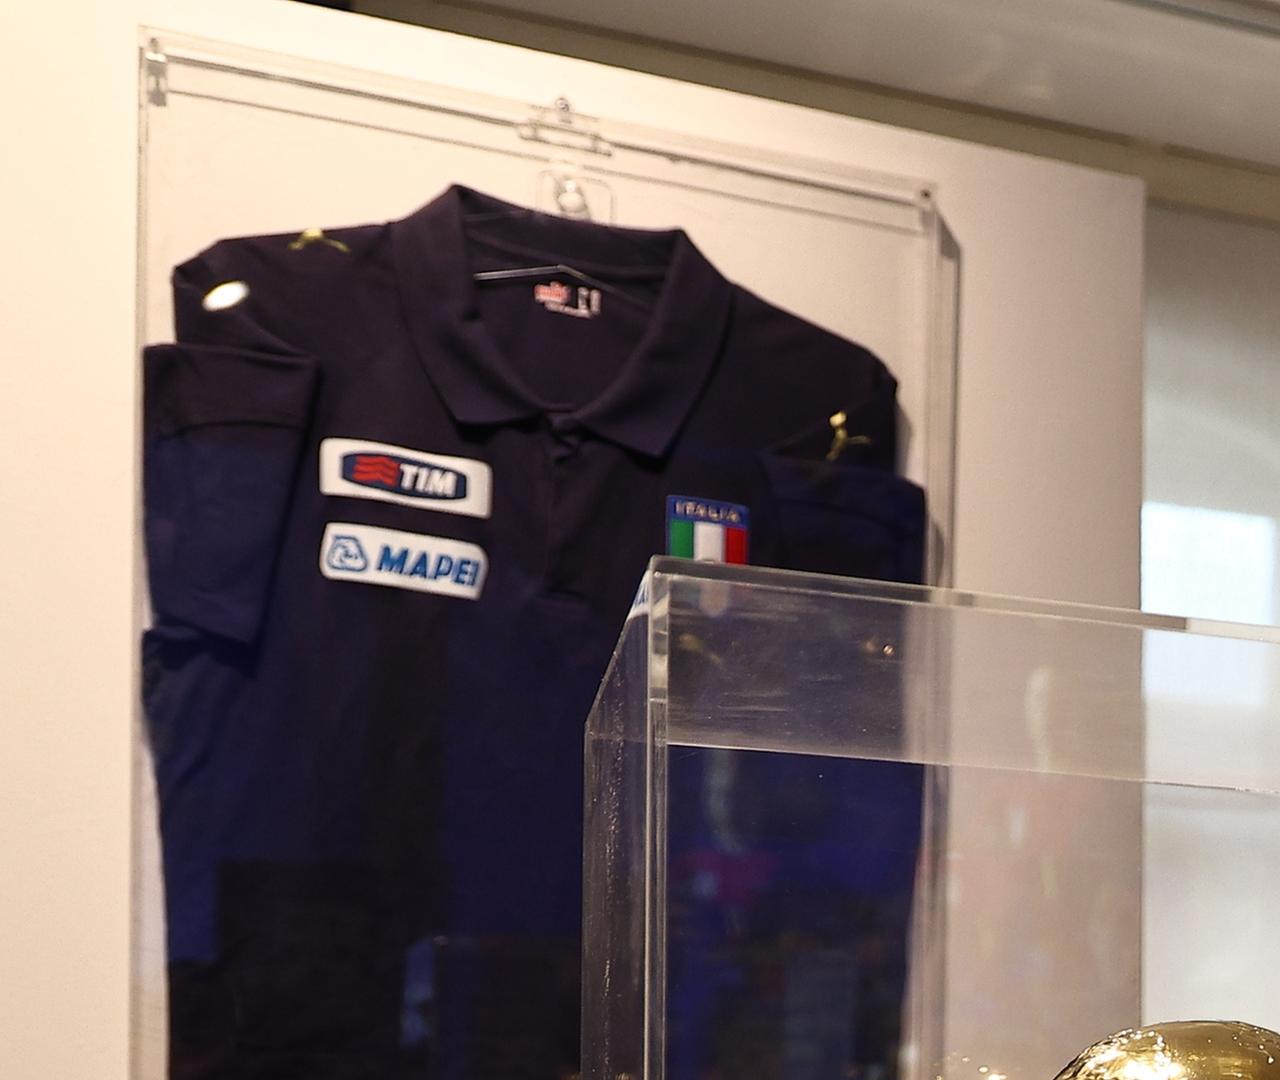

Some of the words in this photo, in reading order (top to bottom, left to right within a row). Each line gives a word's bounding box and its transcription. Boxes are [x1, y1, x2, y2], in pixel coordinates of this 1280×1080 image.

[399, 462, 458, 497] TIM
[675, 501, 741, 523] ITALIA
[376, 545, 480, 587] MAPEI
